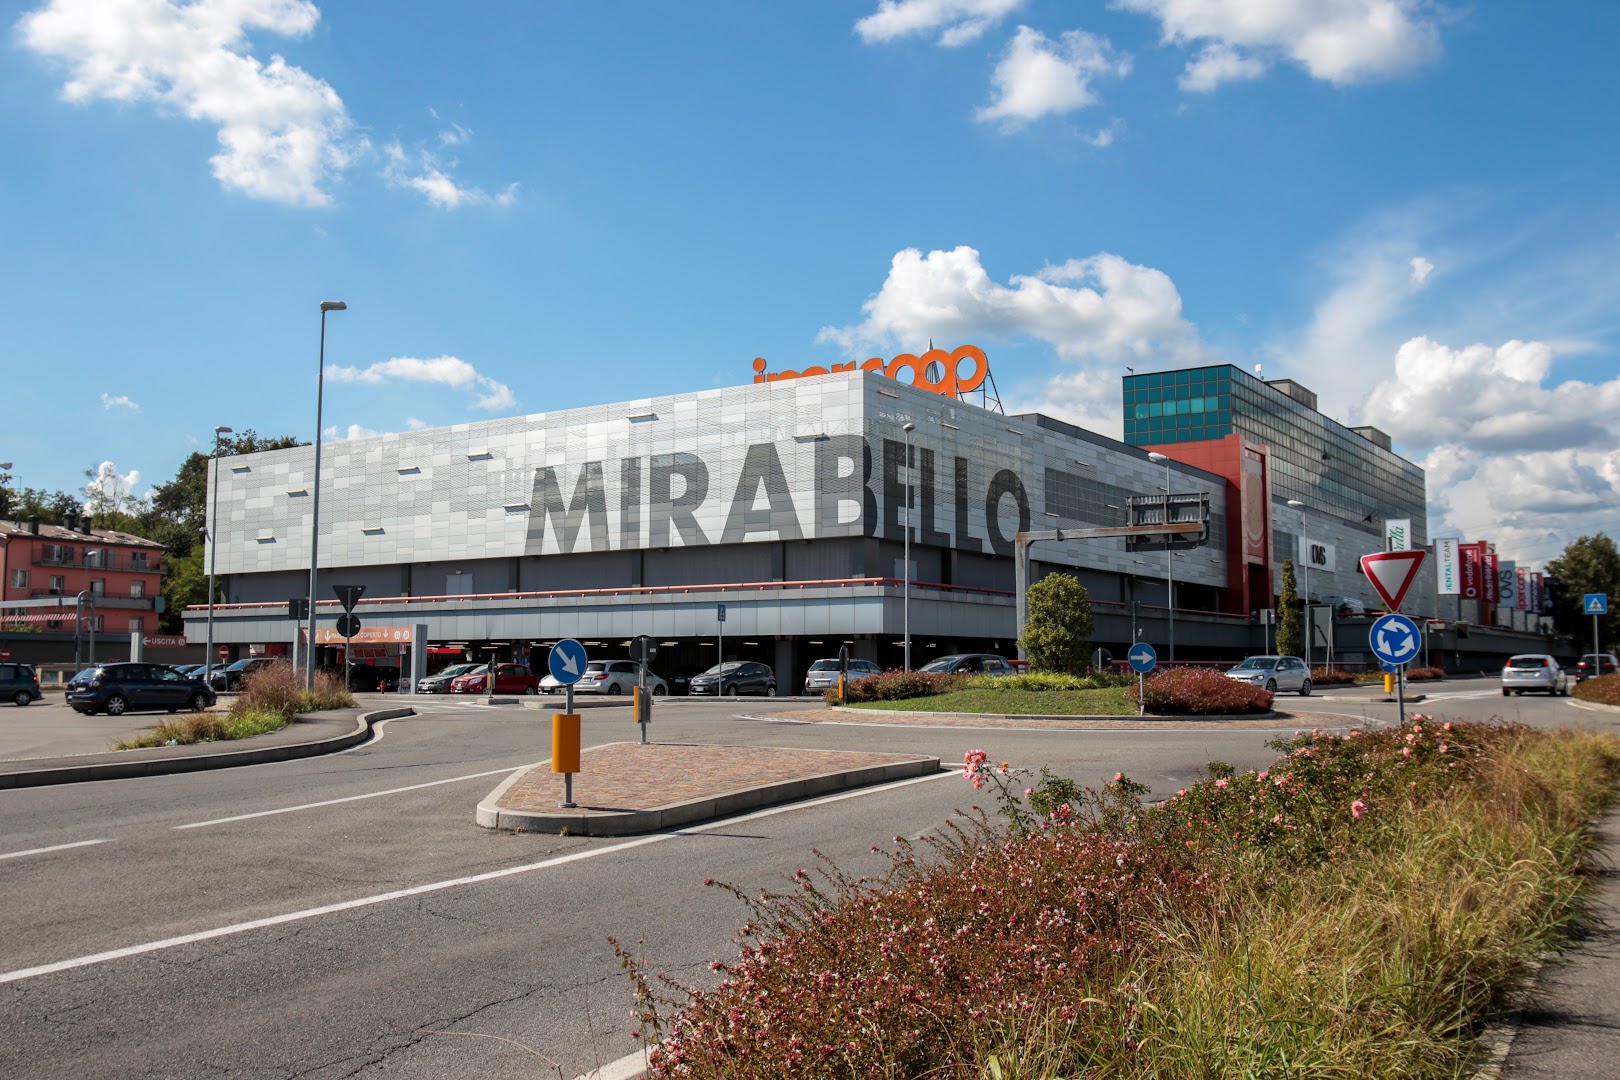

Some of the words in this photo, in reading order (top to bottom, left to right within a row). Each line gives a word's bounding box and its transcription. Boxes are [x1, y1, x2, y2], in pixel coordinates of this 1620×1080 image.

[525, 434, 1031, 558] MIRABELLO
[1311, 544, 1326, 565] OVS
[1464, 549, 1473, 586] vodafone
[1500, 569, 1513, 599] OVS
